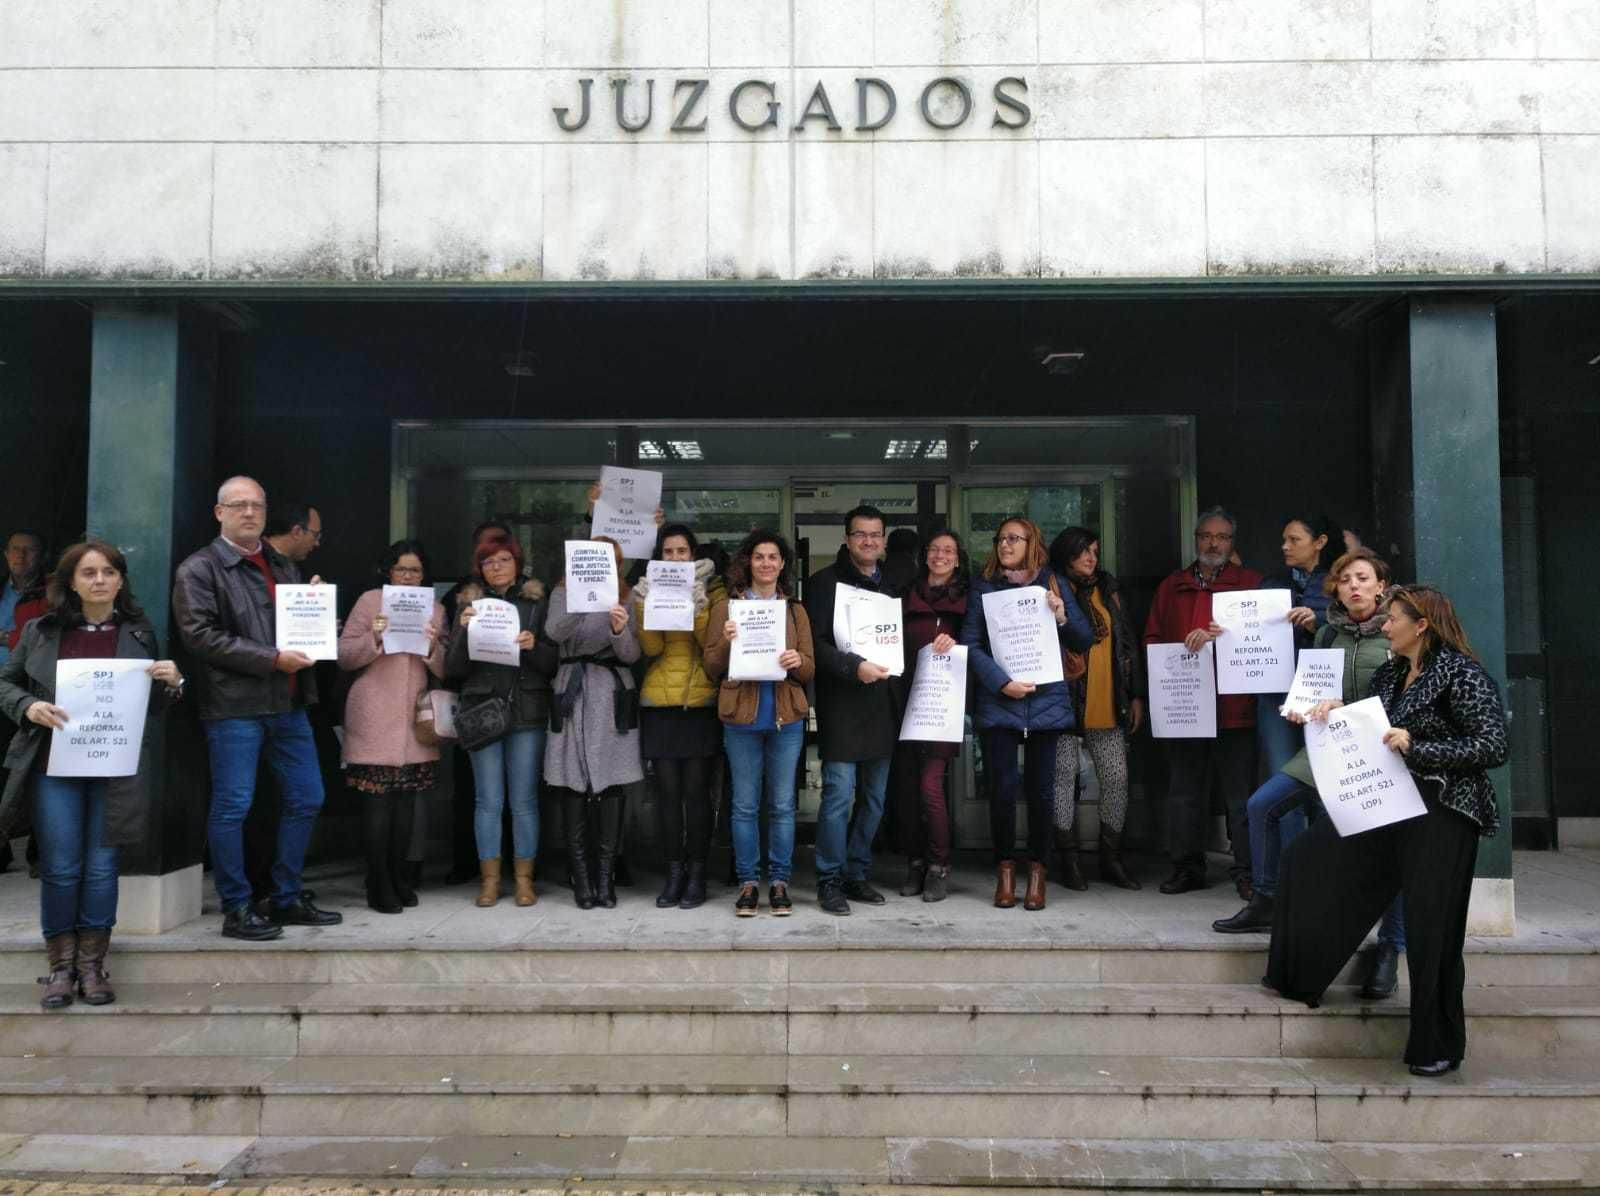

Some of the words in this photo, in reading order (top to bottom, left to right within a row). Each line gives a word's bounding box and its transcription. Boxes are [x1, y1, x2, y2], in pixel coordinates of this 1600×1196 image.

[552, 77, 1032, 133] JUZGADOS
[1017, 598, 1037, 606] SPJ
[875, 624, 897, 633] SPJ
[1328, 720, 1348, 732] SPJ
[1342, 744, 1359, 754] NO
[88, 751, 110, 759] LOPJ
[1355, 759, 1366, 768] LA
[1340, 768, 1384, 786] REFORMA
[1339, 794, 1355, 802] DEL
[1378, 779, 1394, 790] 521
[1362, 798, 1382, 810] LOPJ
